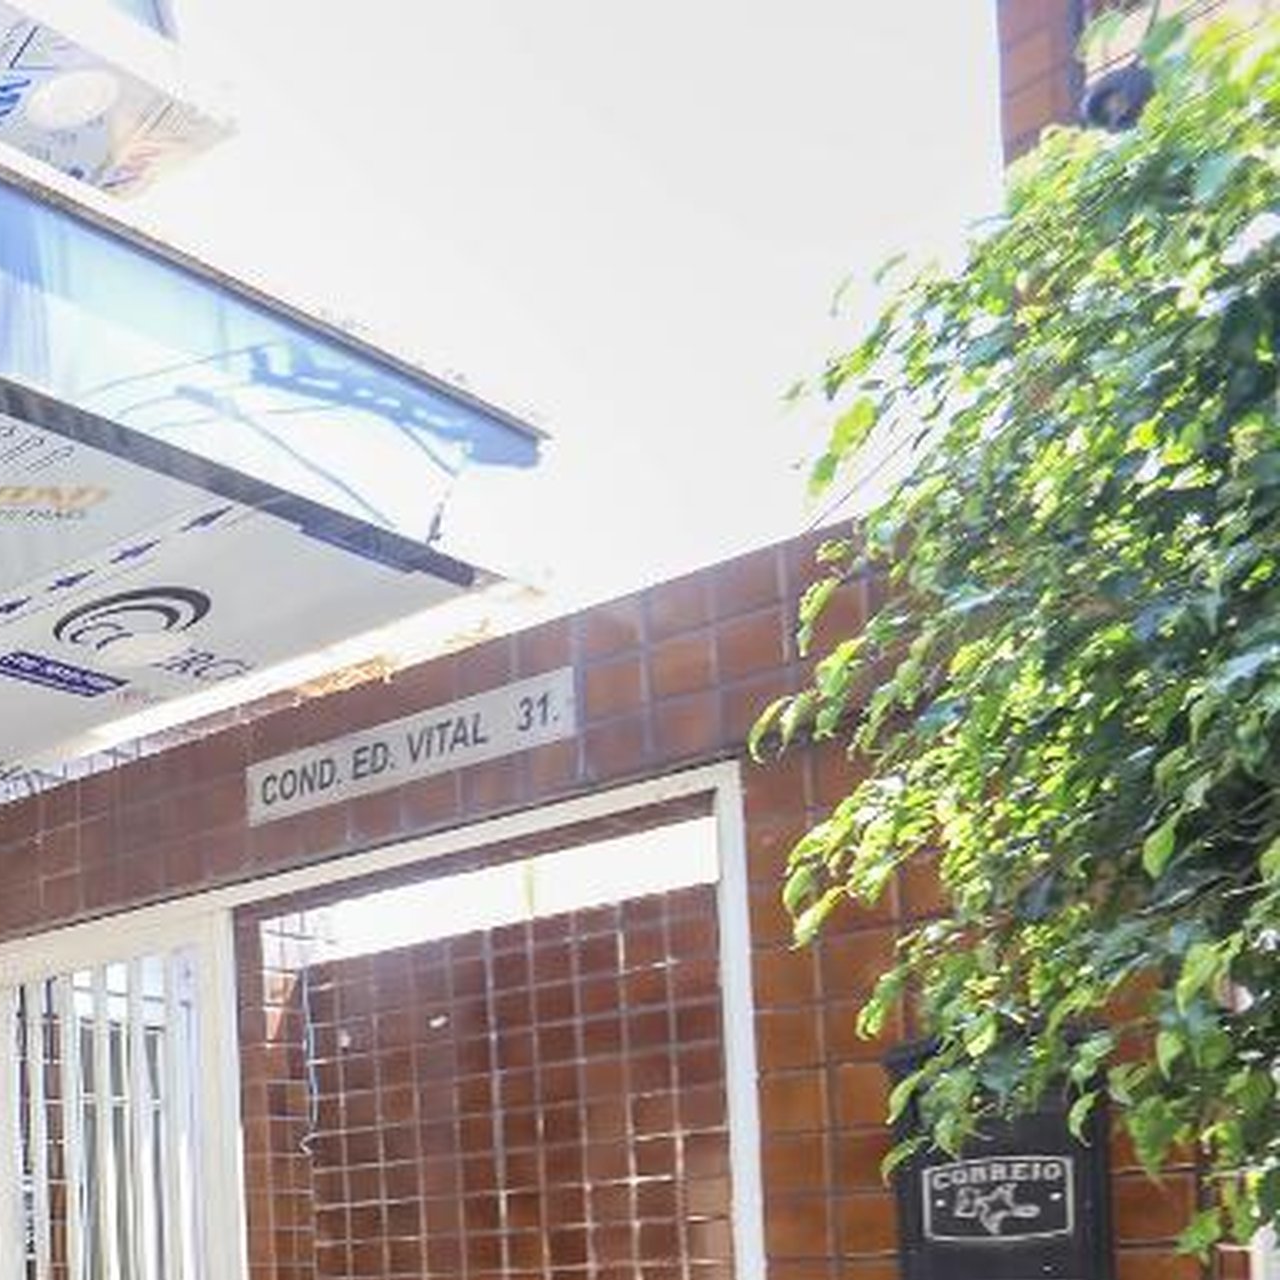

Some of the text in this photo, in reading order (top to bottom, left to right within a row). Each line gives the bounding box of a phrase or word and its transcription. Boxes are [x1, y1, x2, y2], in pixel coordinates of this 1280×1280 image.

[261, 758, 341, 805] COND.
[351, 741, 395, 781] ED.
[406, 711, 489, 764] VITAL
[933, 1162, 1063, 1190] CORREIO
